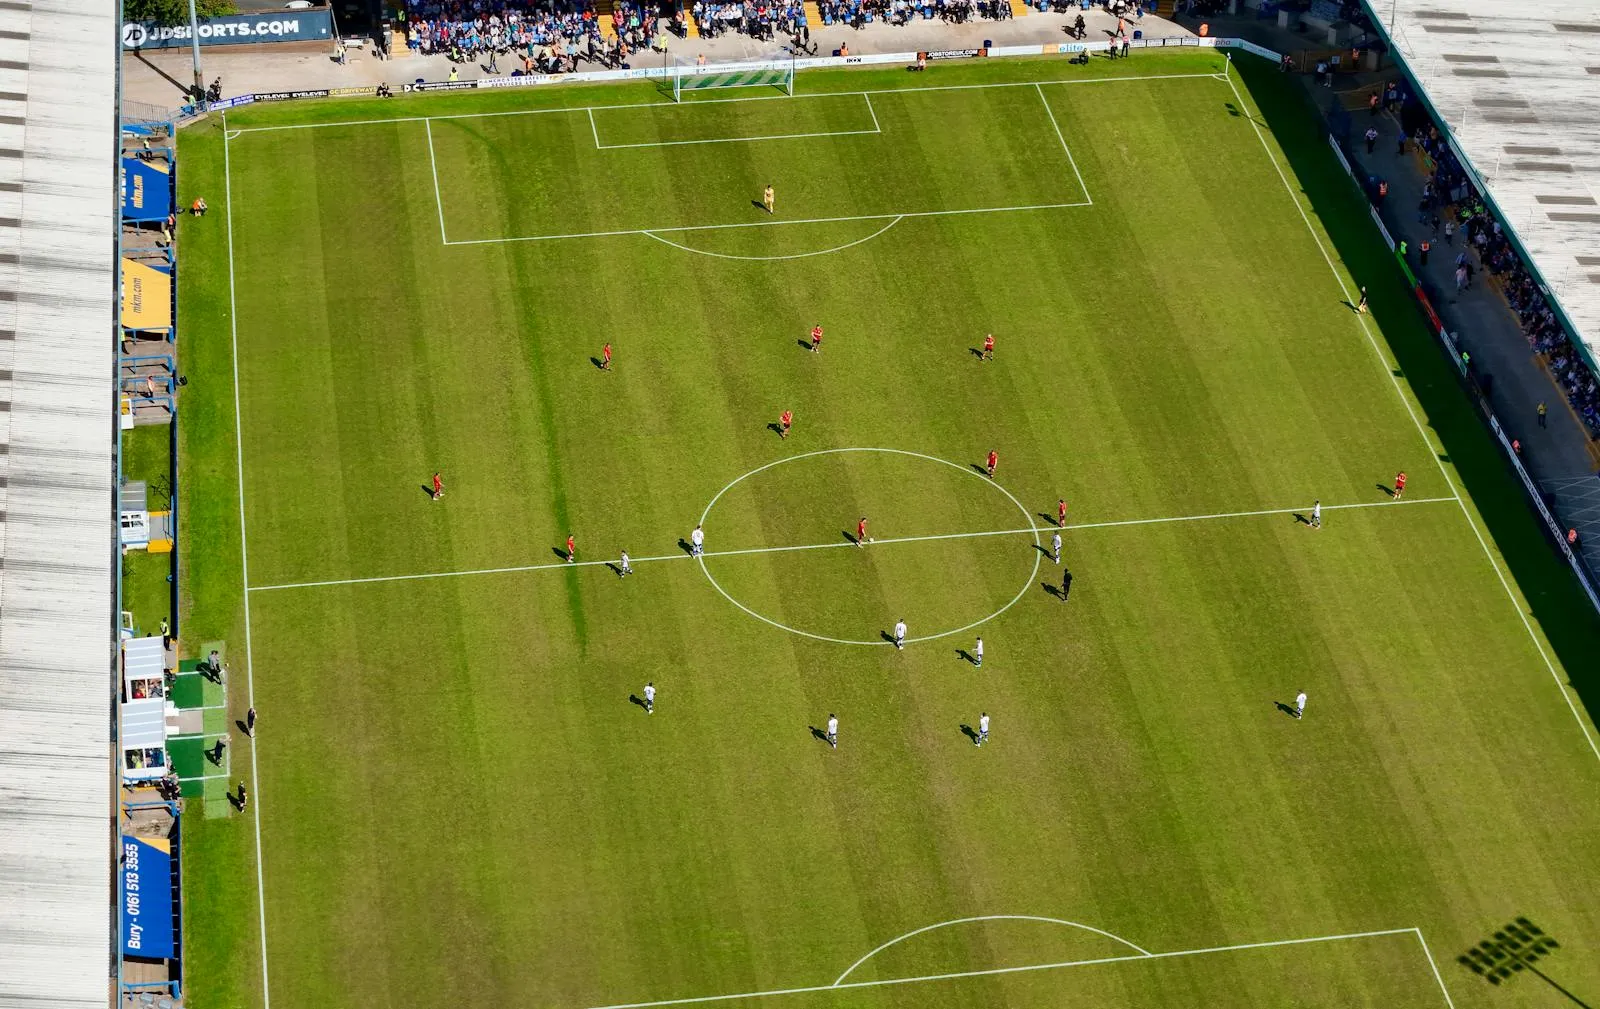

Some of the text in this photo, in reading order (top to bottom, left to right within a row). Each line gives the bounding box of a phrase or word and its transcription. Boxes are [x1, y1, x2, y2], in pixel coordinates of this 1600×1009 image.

[1059, 44, 1083, 52] elite
[292, 90, 327, 98] EYELEVEL
[130, 277, 142, 313] mkm.com
[125, 843, 139, 871] 3555
[125, 872, 140, 891] 513
[126, 892, 140, 916] 0161
[127, 922, 144, 949] Bury
